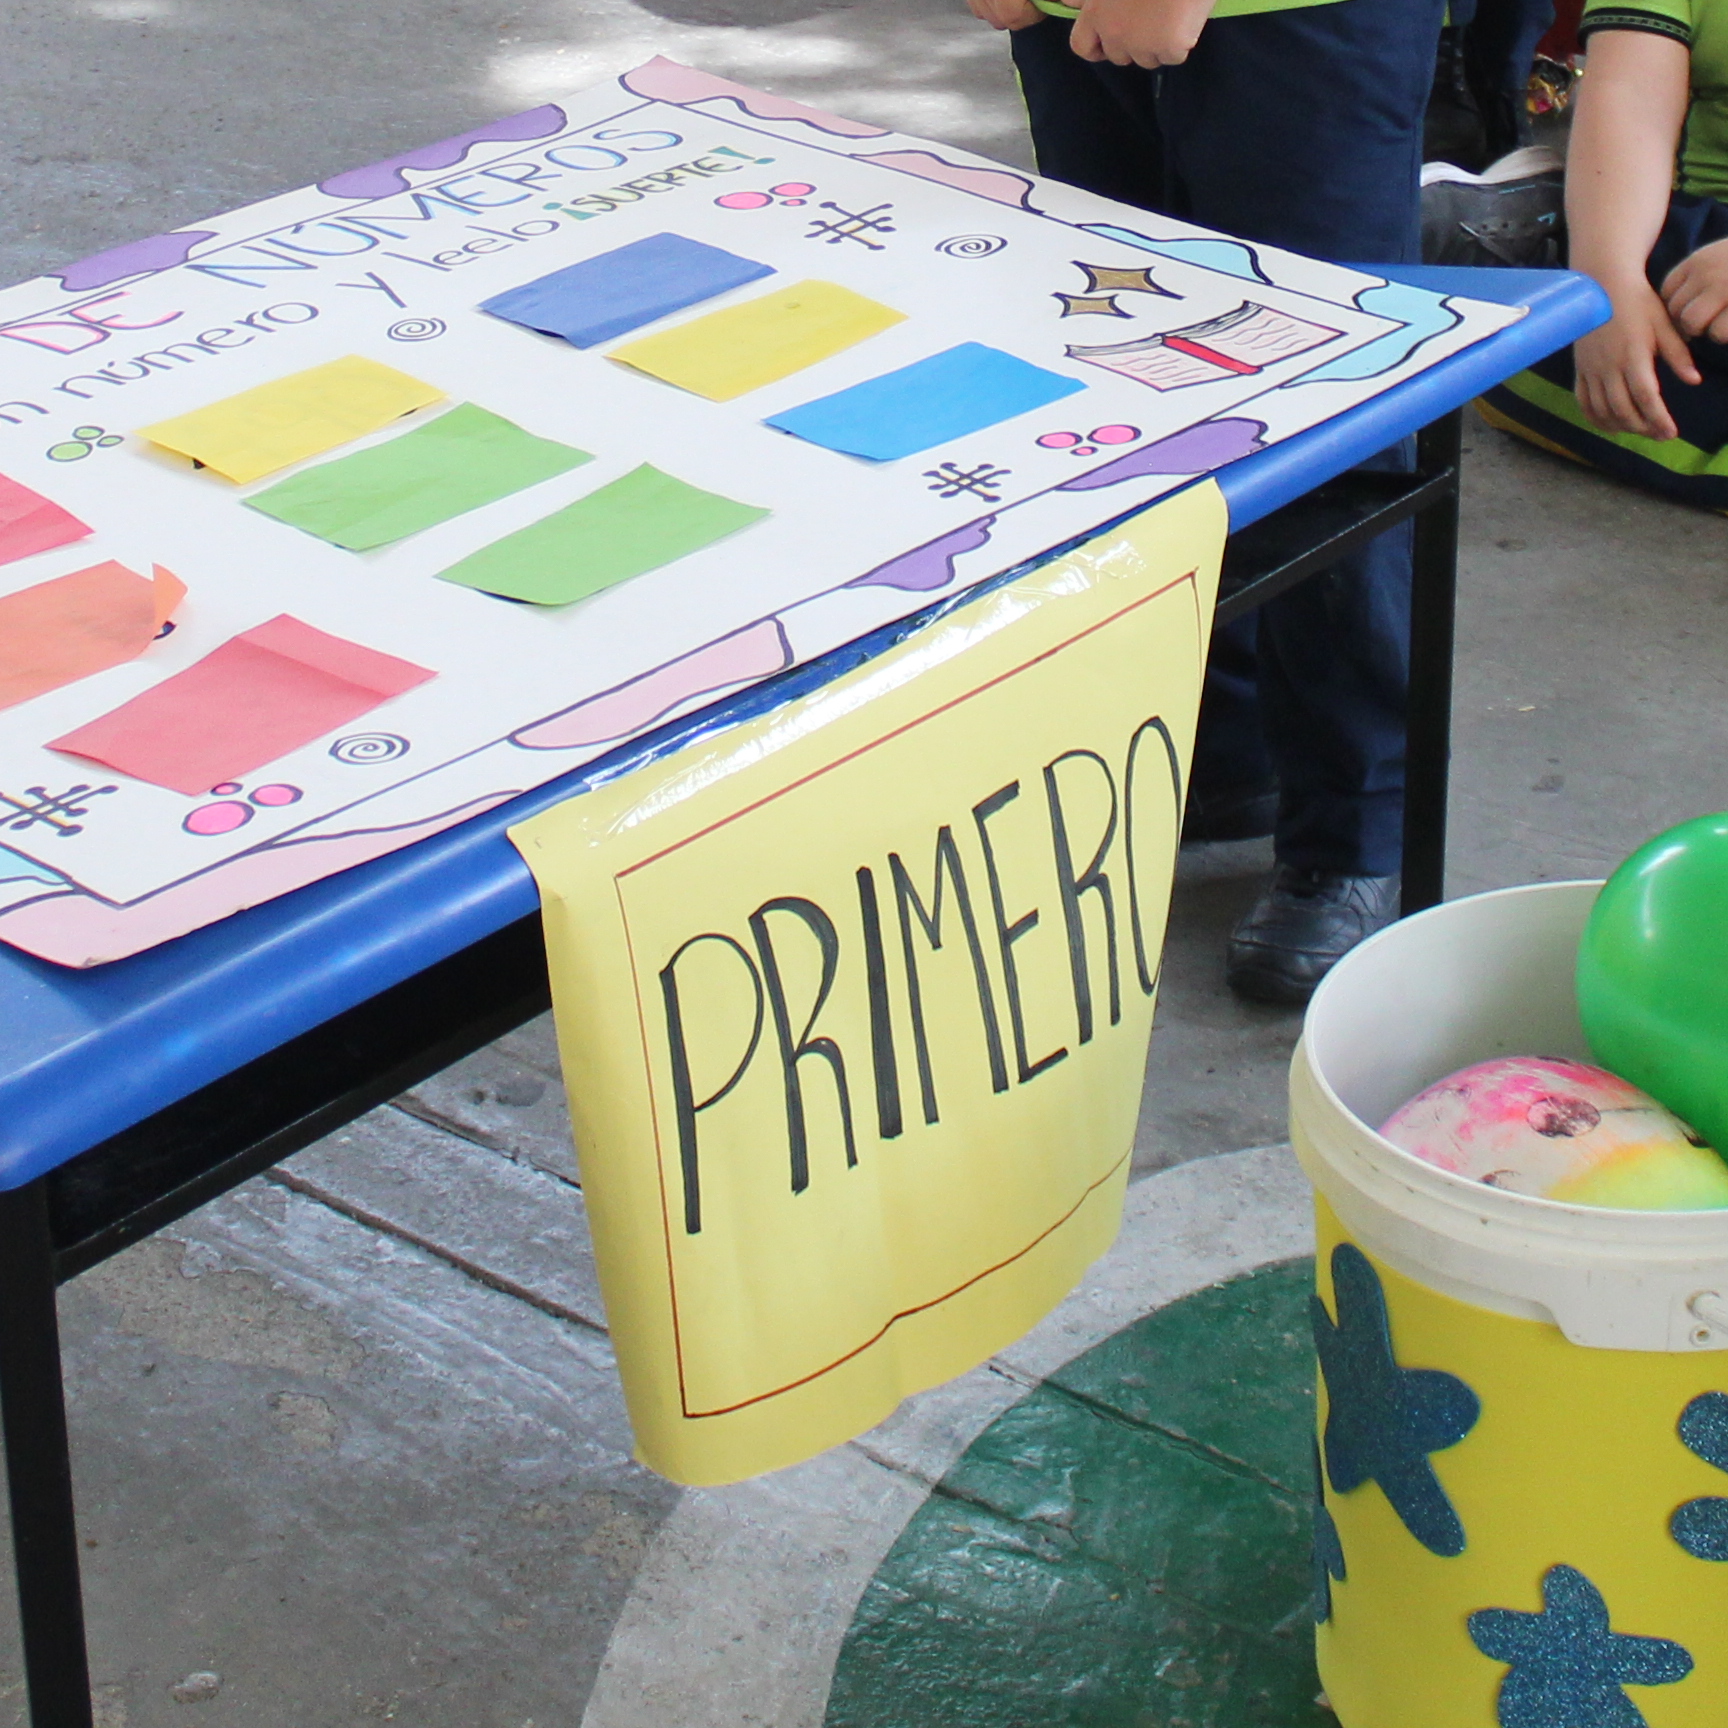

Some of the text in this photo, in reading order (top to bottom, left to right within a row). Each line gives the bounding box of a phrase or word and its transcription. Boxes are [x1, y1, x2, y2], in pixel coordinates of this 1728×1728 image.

[185, 126, 684, 289] NÚMEROS
[52, 300, 320, 401] número
[660, 715, 1183, 1236] PRIMERO
